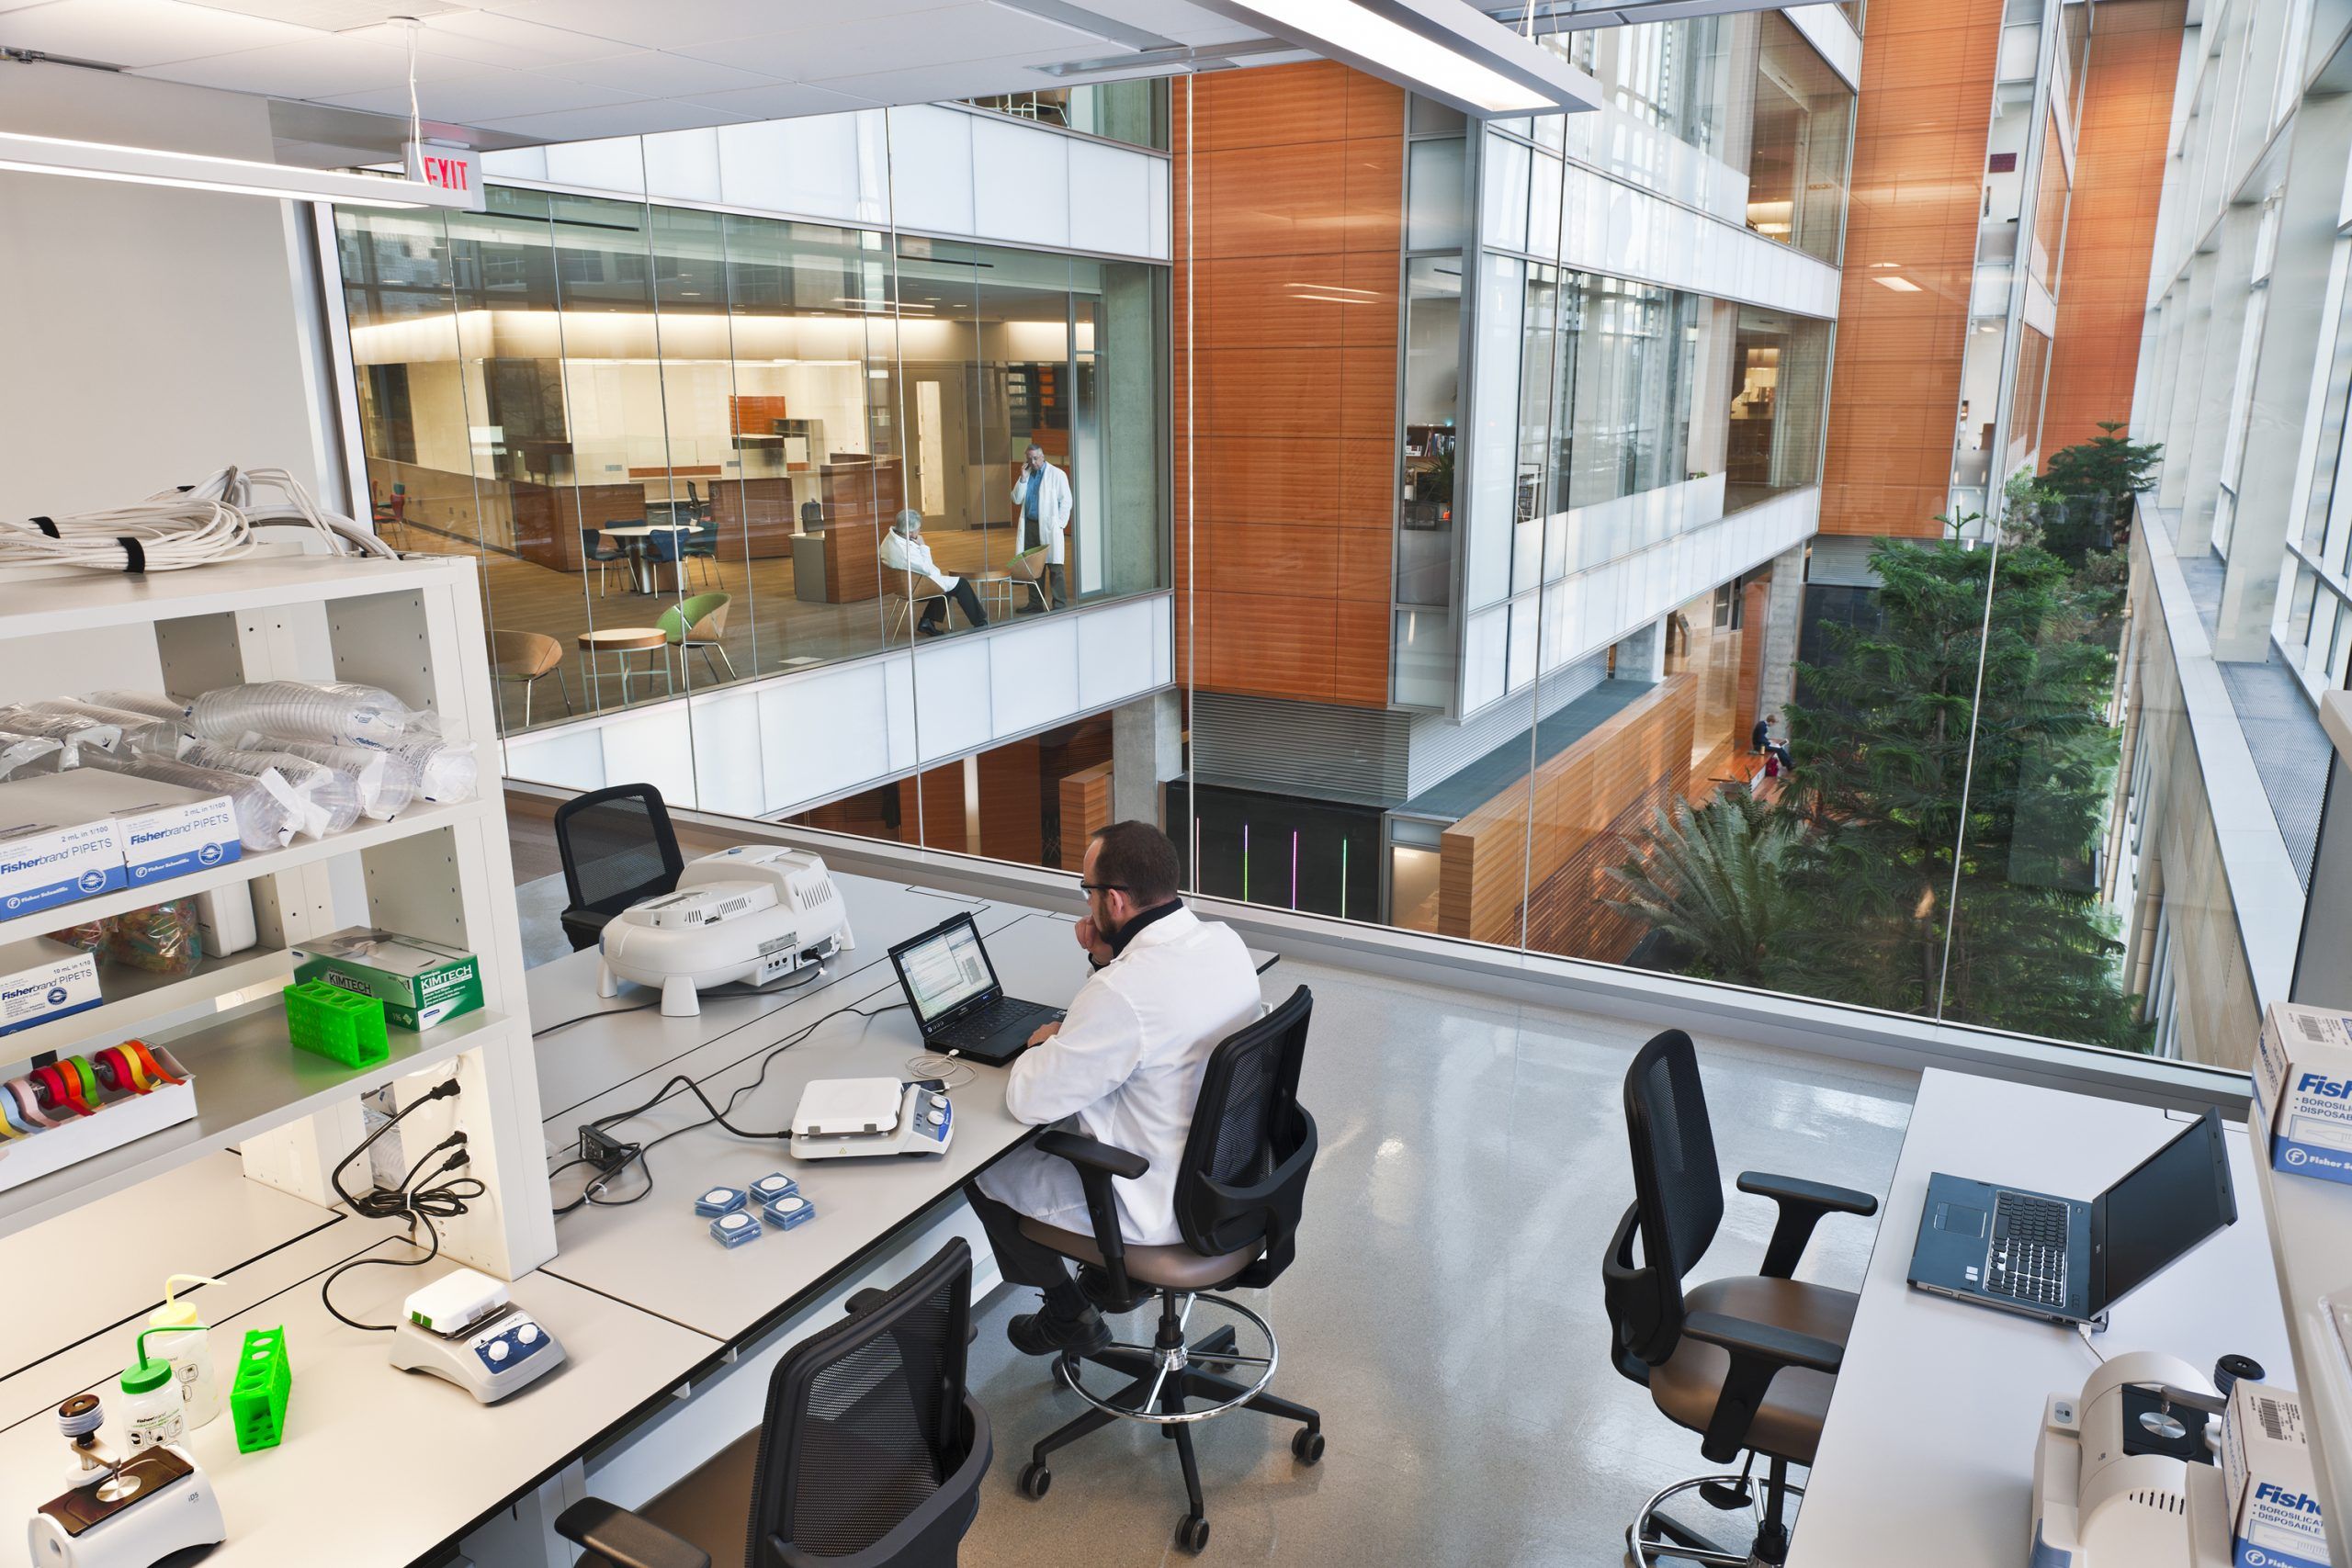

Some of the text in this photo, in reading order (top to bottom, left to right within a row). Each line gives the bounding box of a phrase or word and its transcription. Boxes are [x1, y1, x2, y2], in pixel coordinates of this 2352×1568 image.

[424, 155, 468, 191] EXIT
[209, 801, 226, 811] 1/100
[68, 832, 80, 840] mL
[90, 826, 108, 835] 1/100
[130, 823, 191, 845] Fisherbrand
[193, 813, 230, 829] PIPETS
[0, 848, 69, 874] Fisherbrand
[72, 838, 112, 856] PIPETS
[148, 864, 164, 873] Fisher
[165, 858, 190, 868] Scientific
[21, 894, 40, 903] Fisher
[40, 886, 69, 898] Scientific
[2, 978, 57, 1001] Fisherbrand
[59, 969, 93, 984] PIPETS
[329, 973, 371, 994] KIMTECH
[421, 964, 471, 989] KIMTECH
[2309, 1156, 2343, 1168] Fisher
[2255, 1482, 2322, 1516] Fish
[2258, 1511, 2321, 1534] DISPOSABLE
